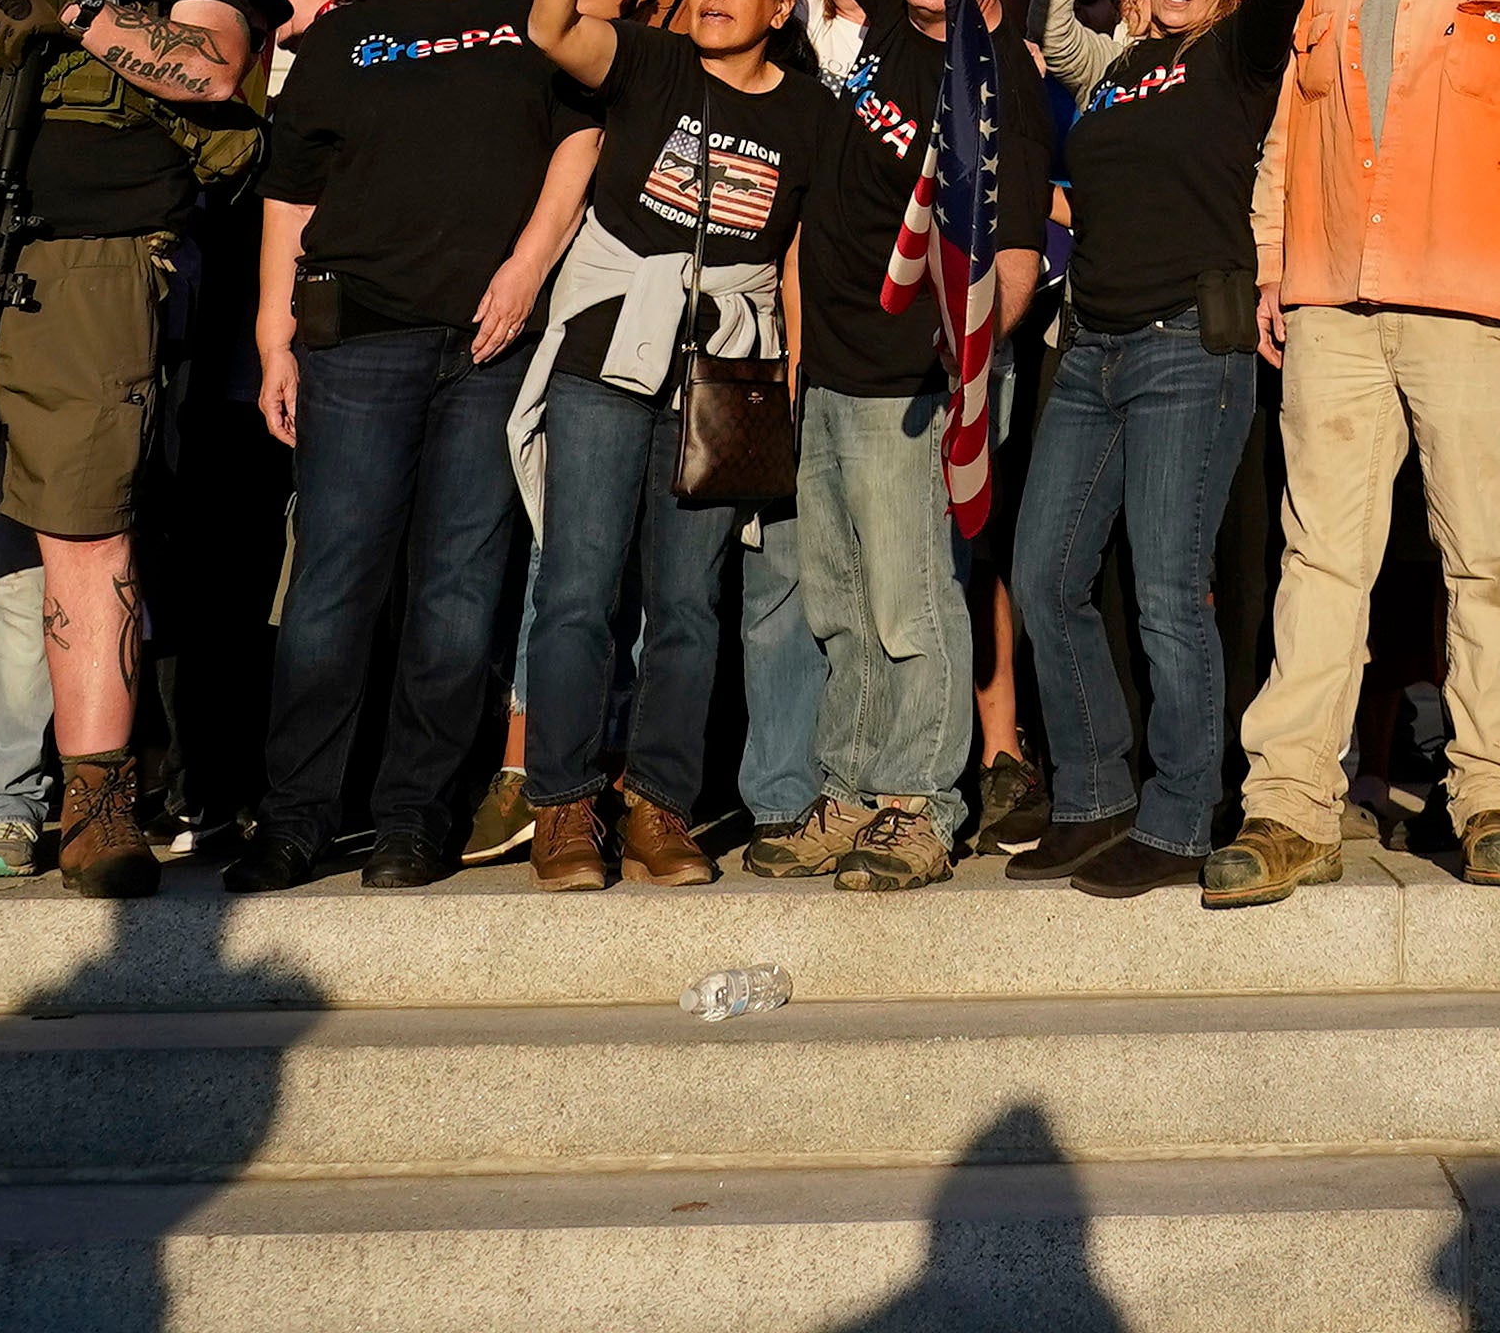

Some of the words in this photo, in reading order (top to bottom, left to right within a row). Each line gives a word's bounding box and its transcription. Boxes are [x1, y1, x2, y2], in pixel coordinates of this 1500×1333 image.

[360, 23, 523, 68] FreePA
[677, 114, 703, 135] RO
[708, 133, 735, 149] OF
[737, 135, 782, 166] IRON
[639, 193, 697, 230] FREEDOM
